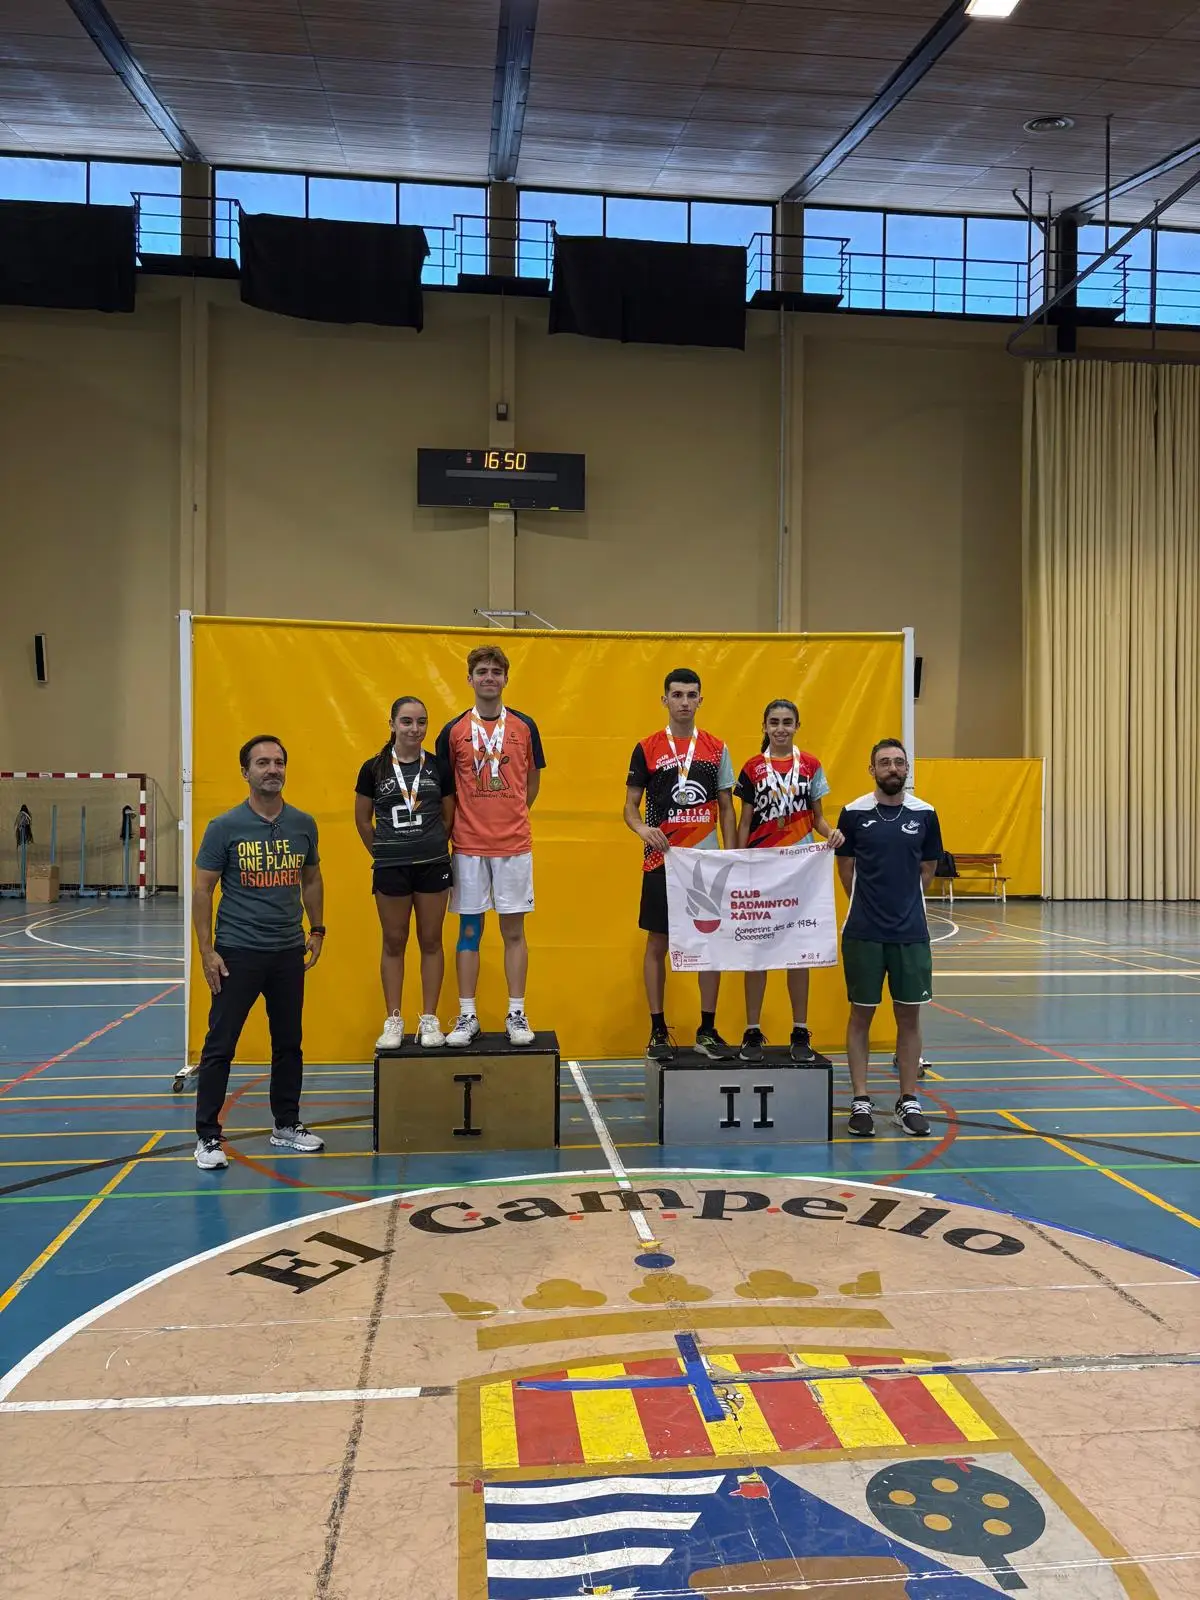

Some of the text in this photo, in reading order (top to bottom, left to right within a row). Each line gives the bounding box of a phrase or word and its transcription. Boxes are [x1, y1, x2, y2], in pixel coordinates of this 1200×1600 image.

[668, 815, 711, 824] MESEGUER
[238, 841, 263, 857] ONE
[239, 856, 263, 872] ONE
[730, 889, 760, 899] CLUB
[730, 897, 799, 910] BADMINTON
[730, 910, 772, 921] XÀTIVA
[452, 1073, 483, 1136] I
[226, 1187, 1026, 1294] El Campello
